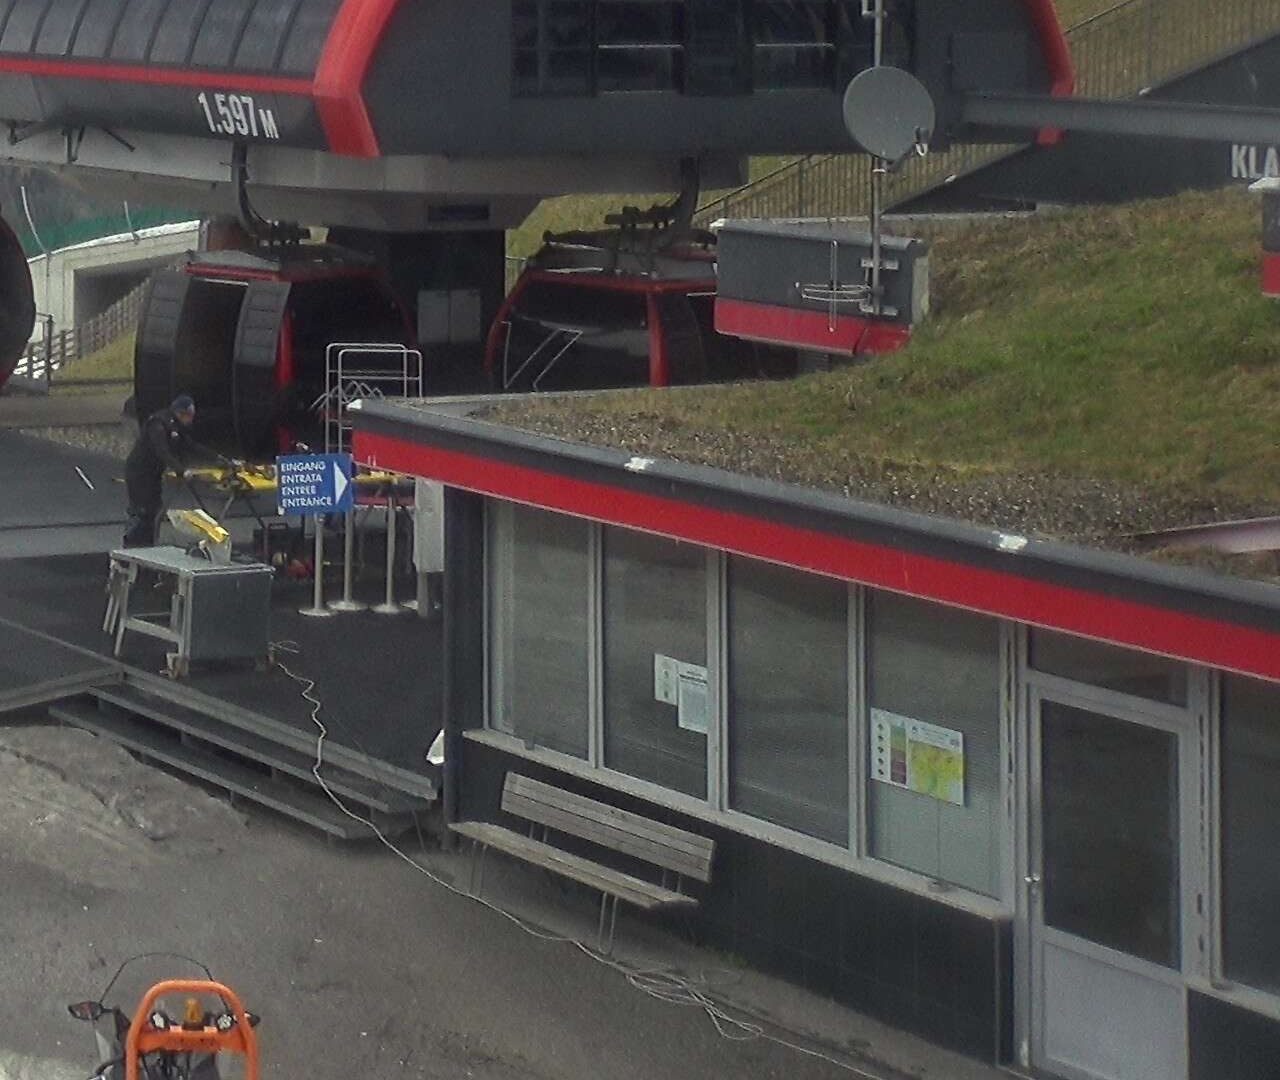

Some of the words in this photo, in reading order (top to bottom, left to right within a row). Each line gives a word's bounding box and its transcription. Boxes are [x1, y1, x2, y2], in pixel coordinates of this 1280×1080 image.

[280, 461, 326, 472] EINGANG
[281, 473, 323, 484] ENTRATA
[282, 496, 333, 508] ENTRANCE
